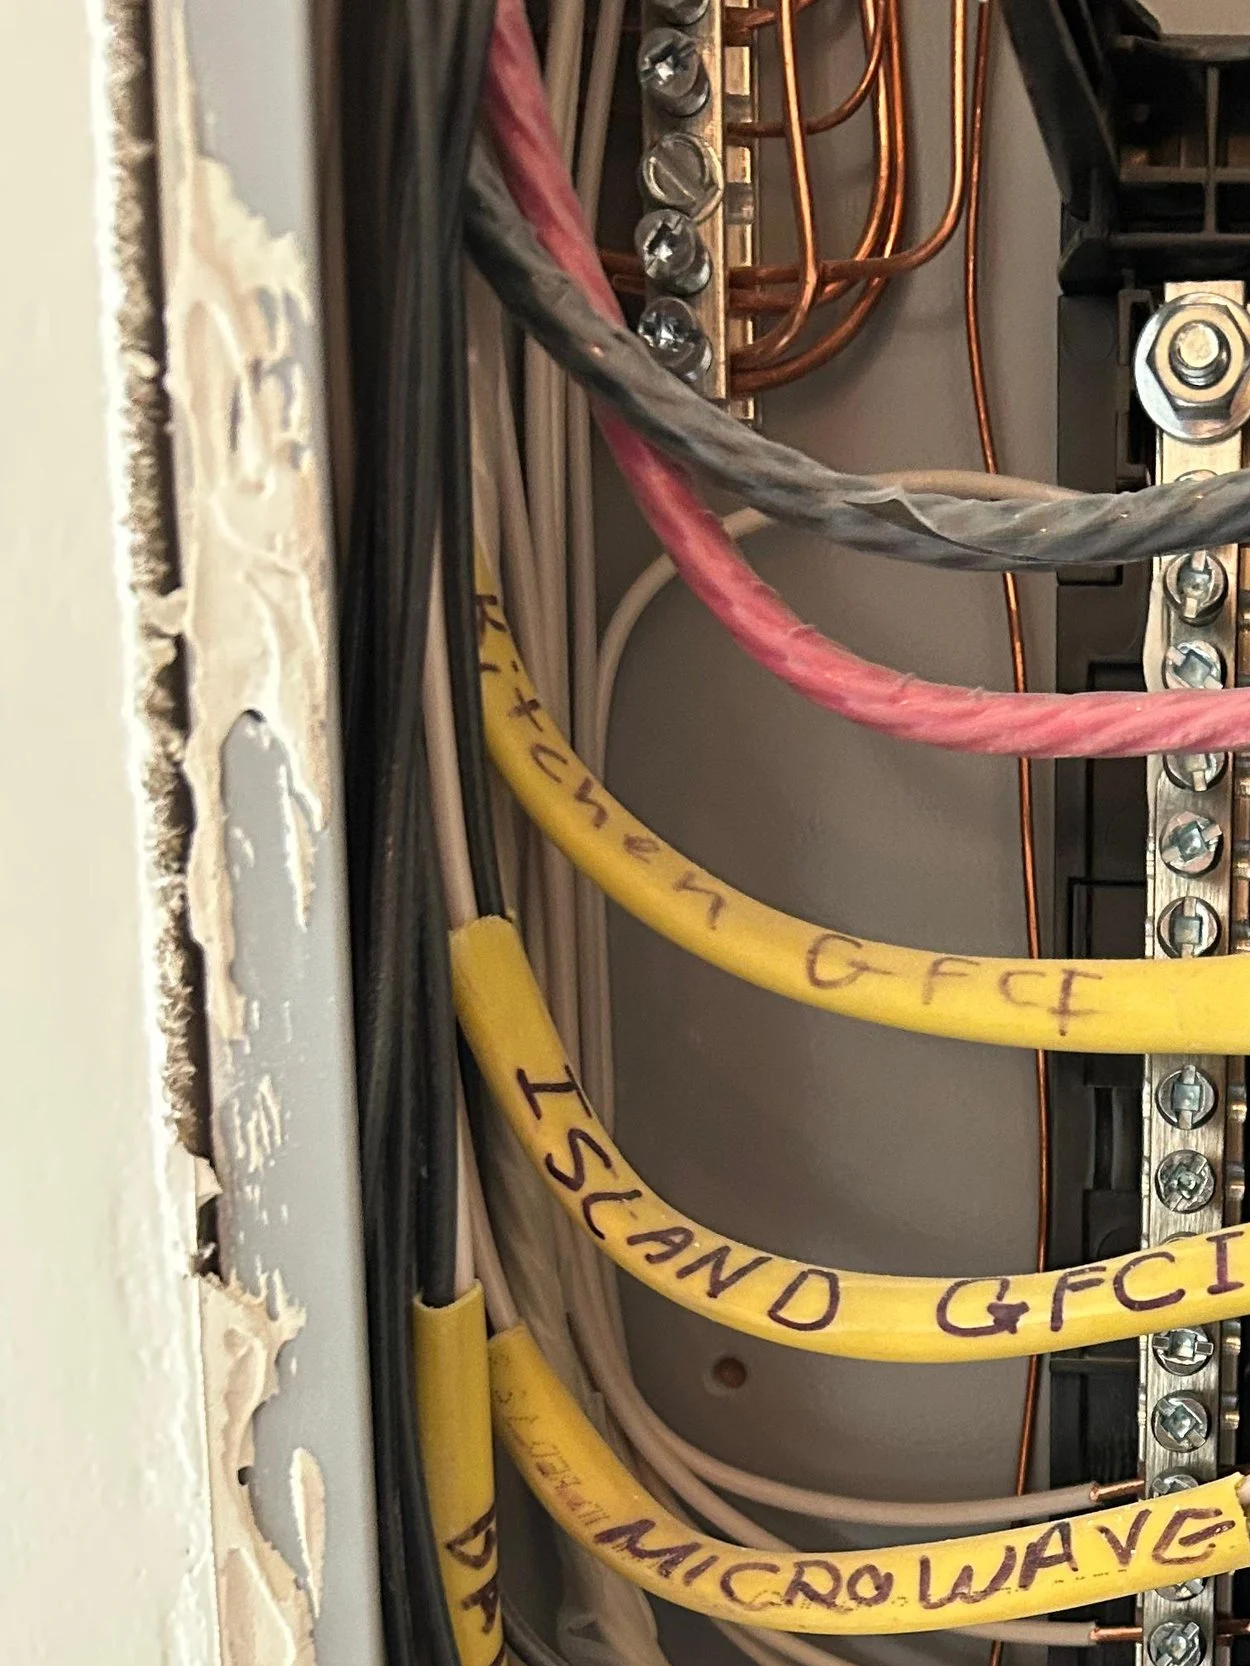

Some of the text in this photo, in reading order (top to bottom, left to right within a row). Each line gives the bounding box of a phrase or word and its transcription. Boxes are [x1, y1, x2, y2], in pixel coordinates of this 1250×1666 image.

[515, 1062, 1246, 1337] ISLAND GFCI
[597, 1507, 1236, 1613] MICROWAVE
